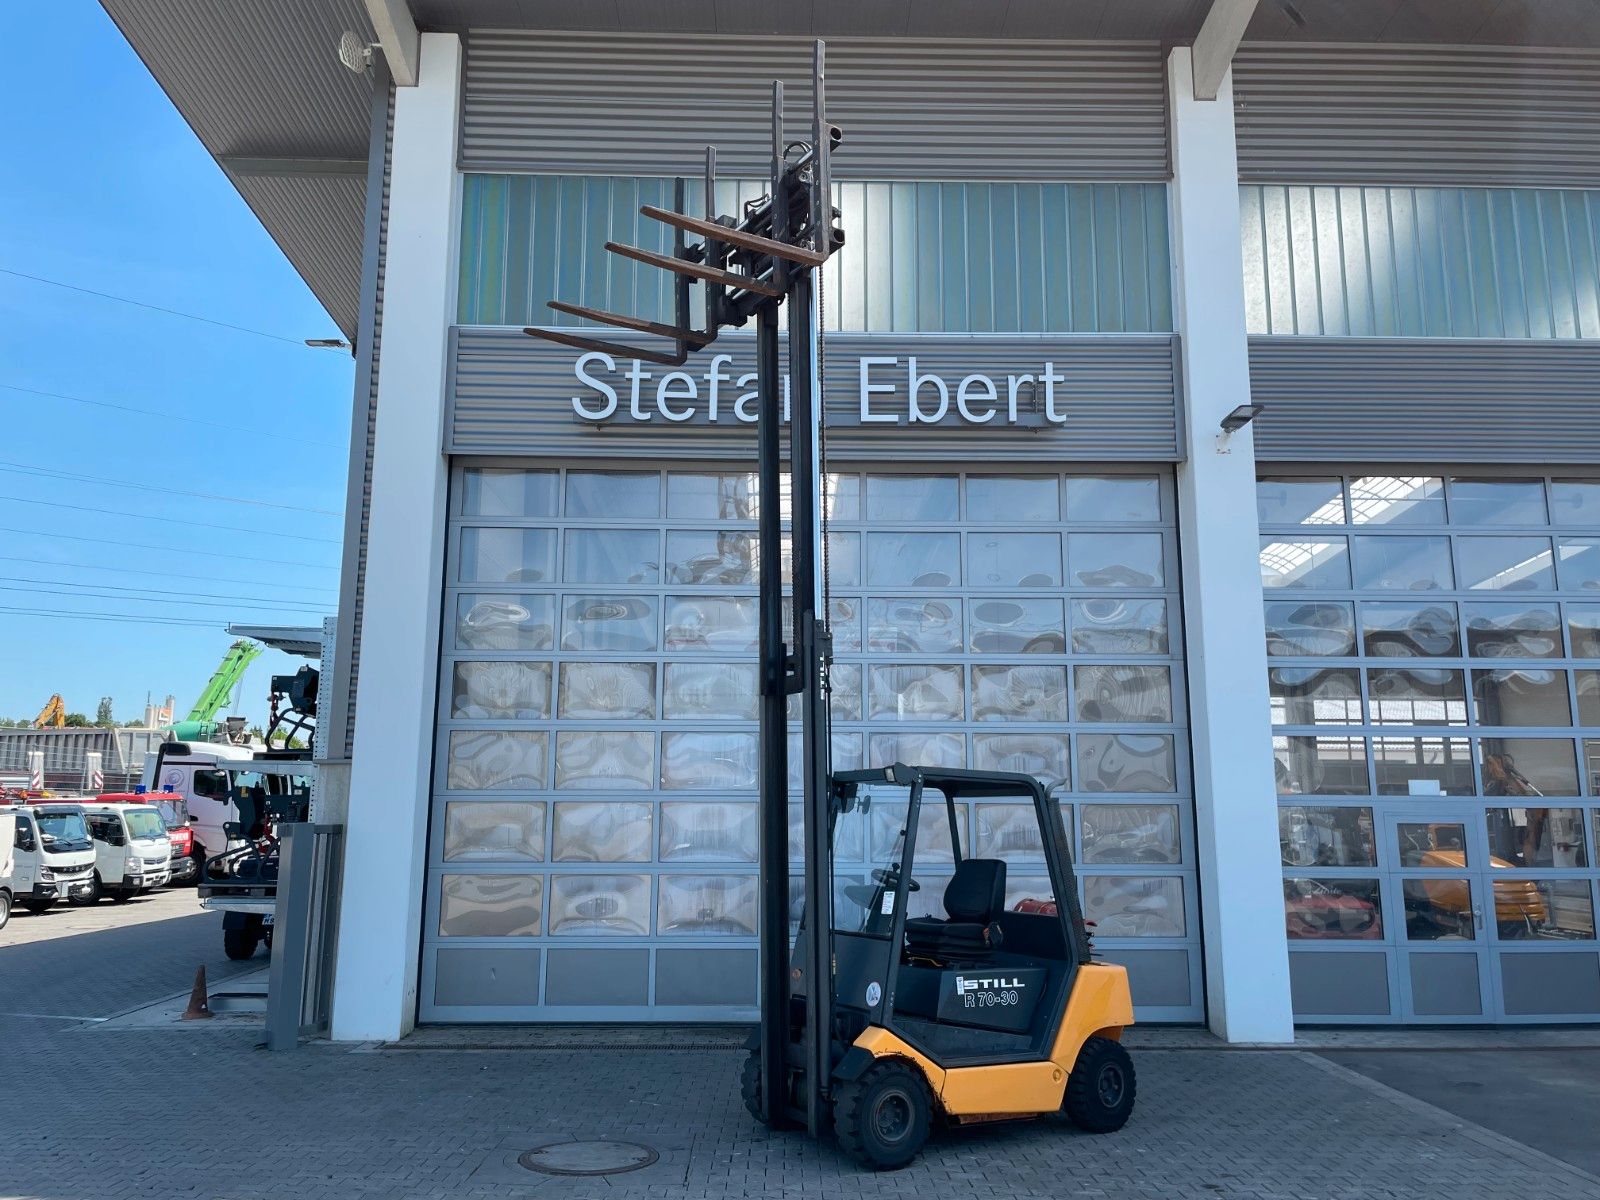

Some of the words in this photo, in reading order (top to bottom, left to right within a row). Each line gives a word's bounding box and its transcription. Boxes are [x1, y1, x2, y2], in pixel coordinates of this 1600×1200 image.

[858, 356, 1067, 424] Ebert
[963, 978, 1025, 989] STILL
[964, 992, 975, 1007] R
[977, 990, 1018, 1006] 70-30
